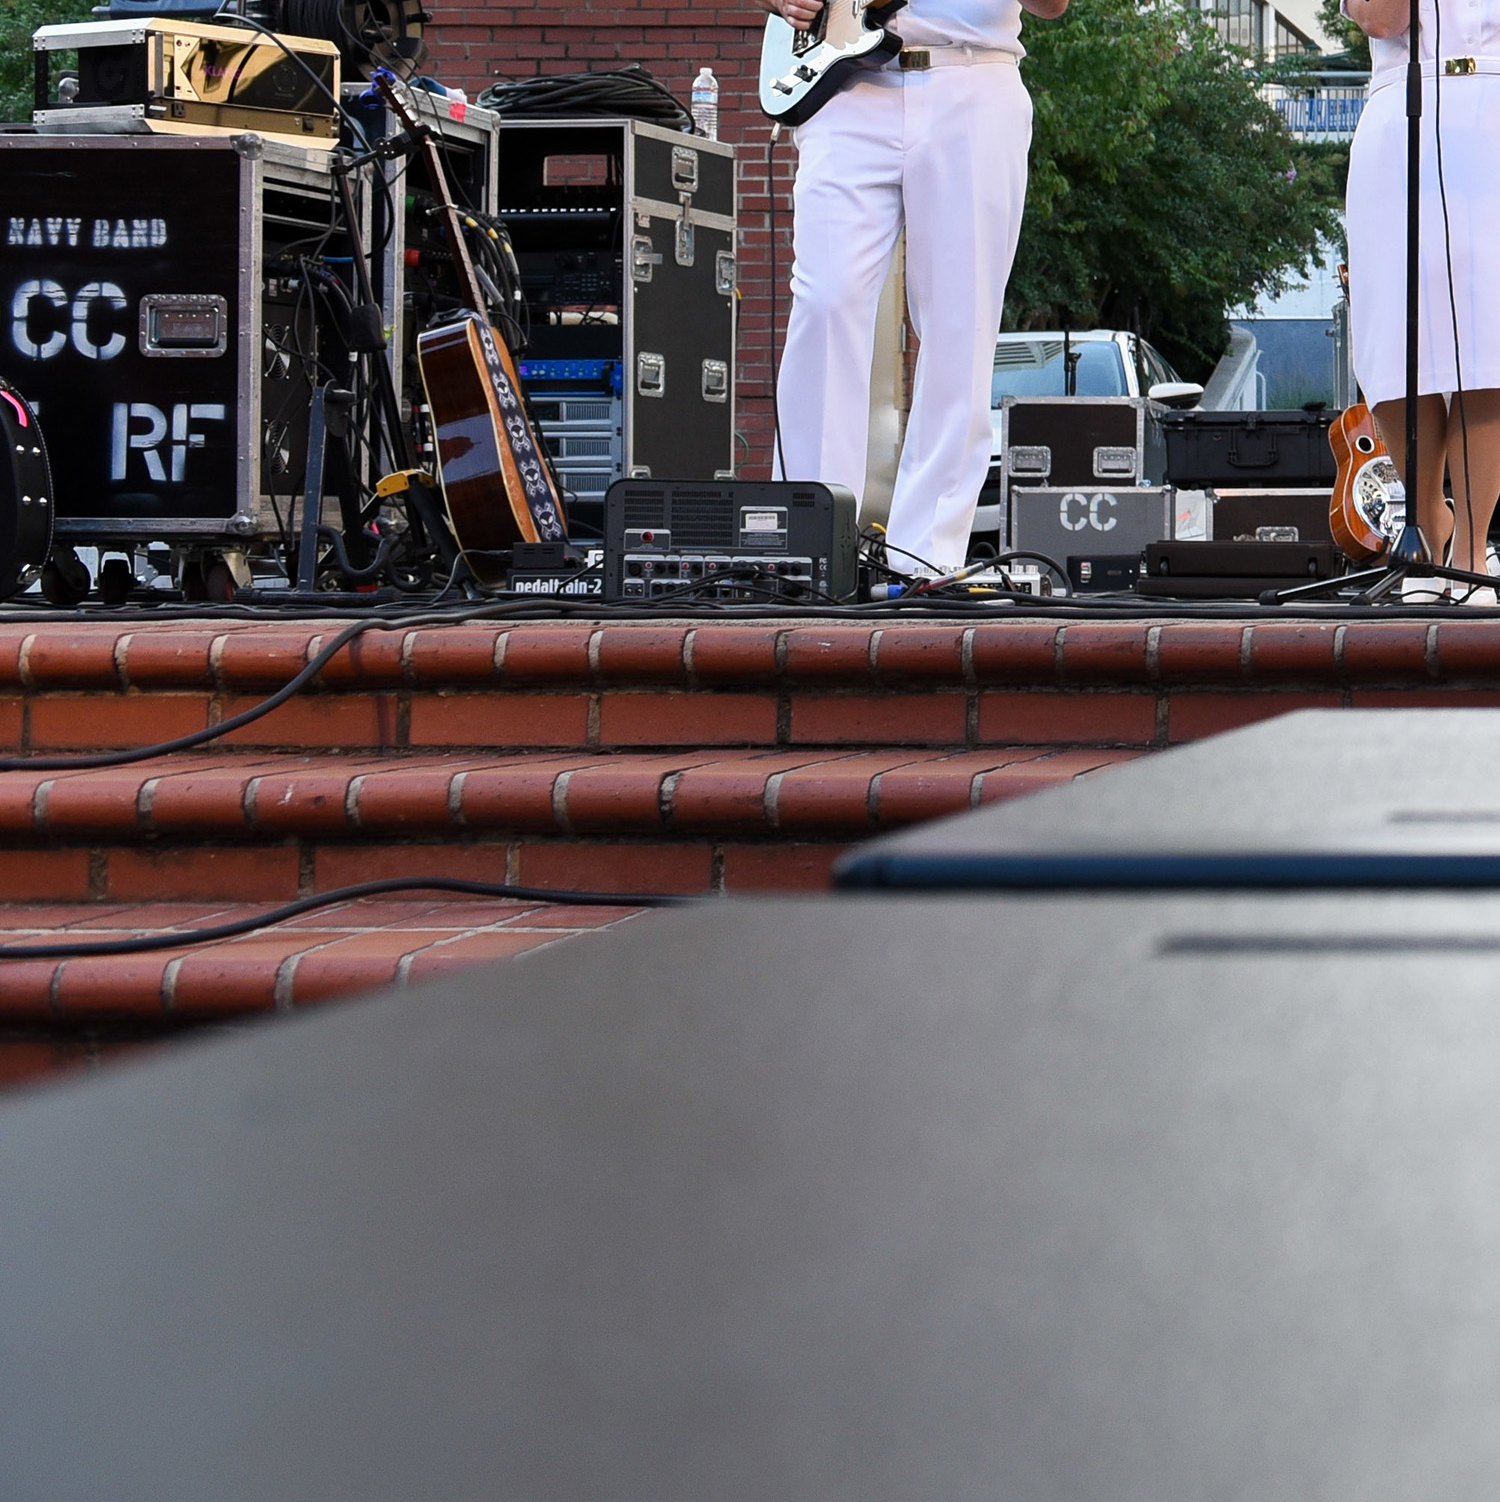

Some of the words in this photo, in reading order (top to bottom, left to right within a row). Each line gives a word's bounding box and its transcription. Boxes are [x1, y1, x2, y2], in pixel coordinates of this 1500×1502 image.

[8, 216, 82, 246] NAVY
[92, 218, 168, 248] BAND
[12, 279, 128, 360] CC
[110, 402, 226, 482] RF
[1060, 493, 1118, 531] CC
